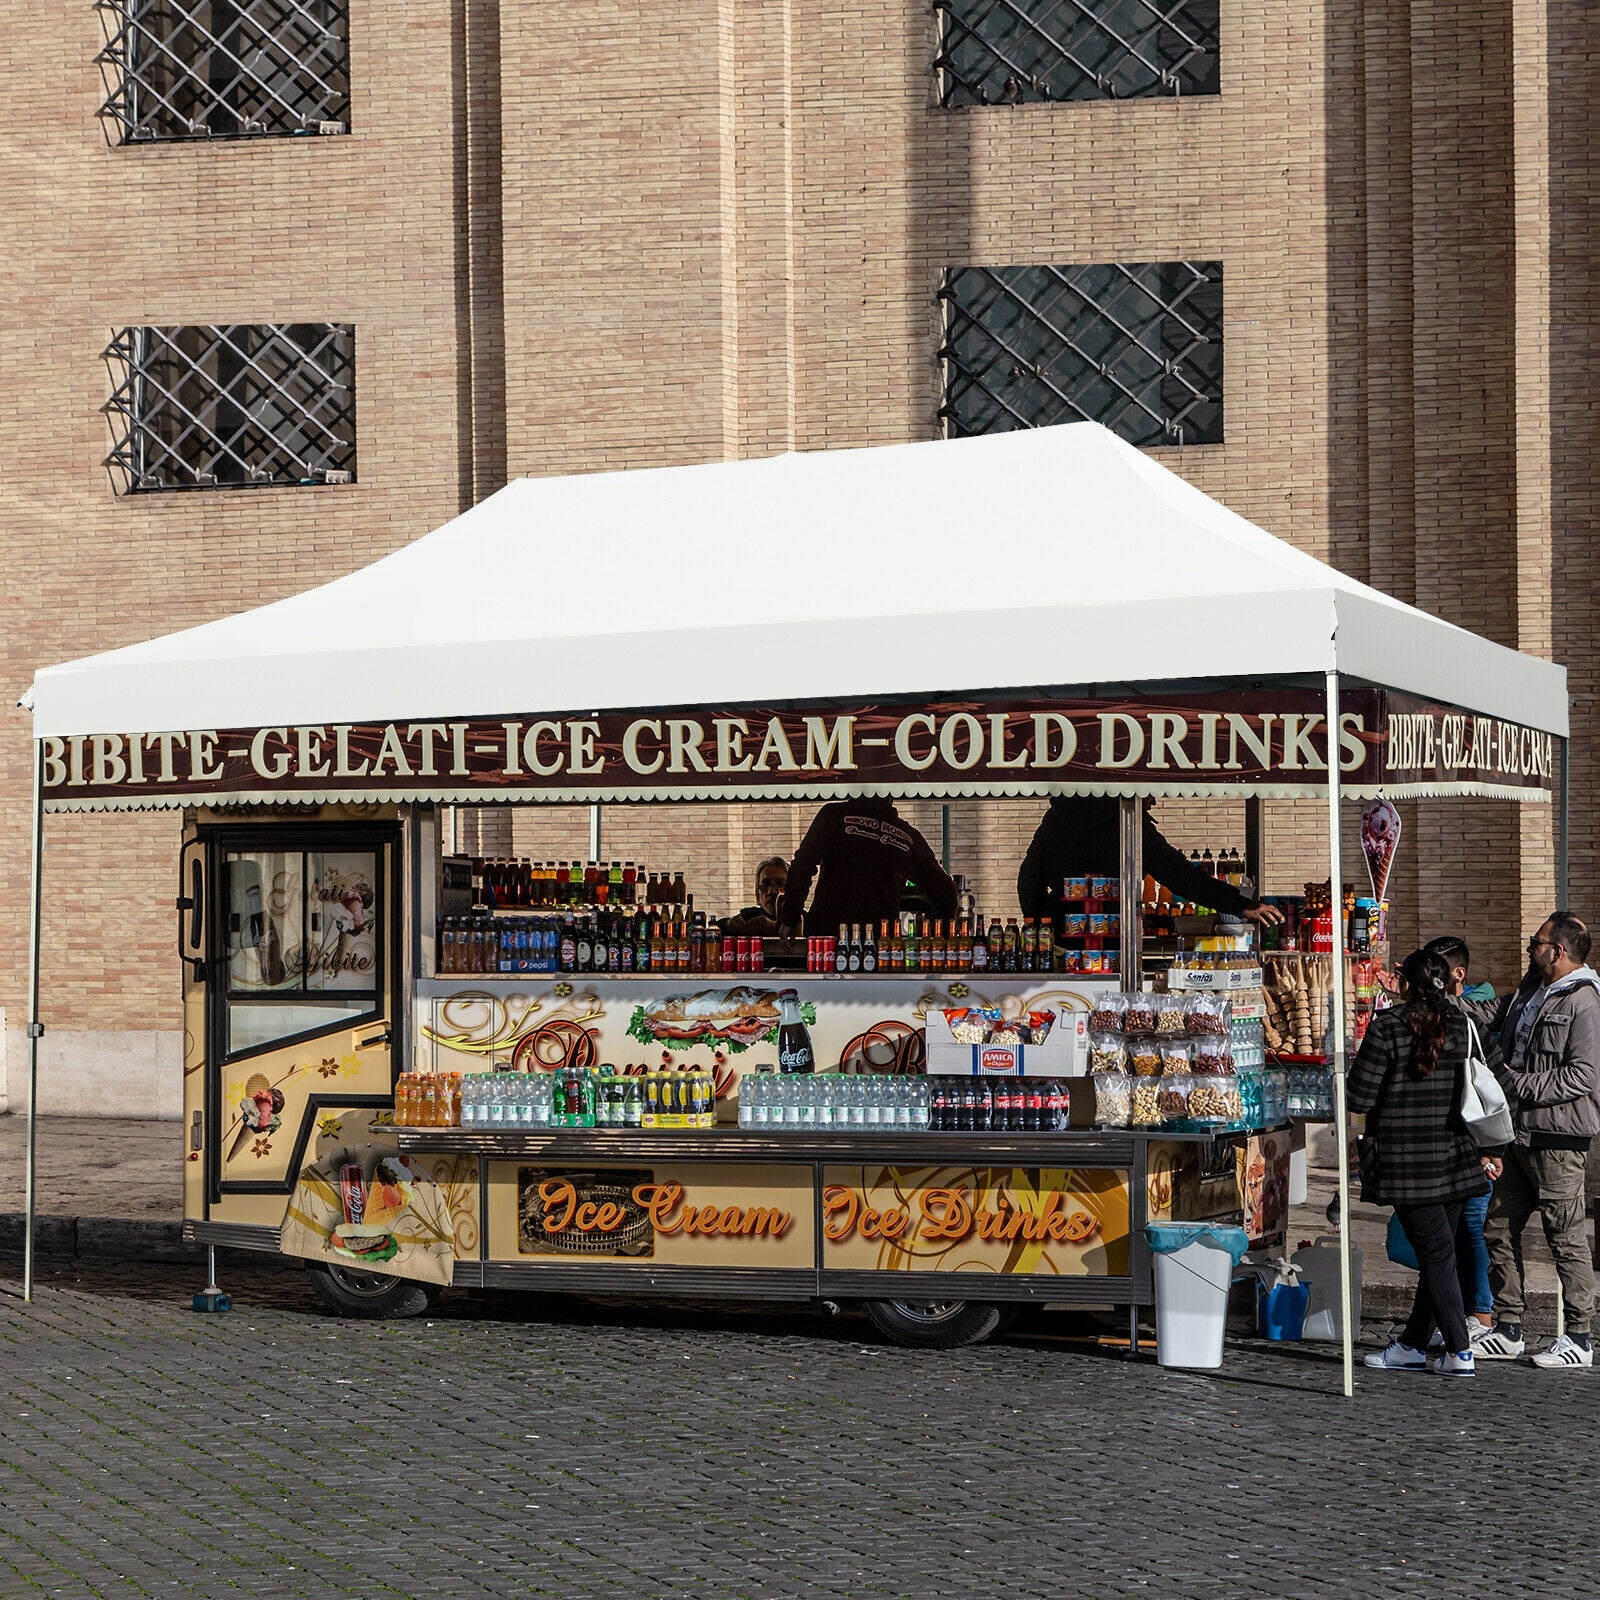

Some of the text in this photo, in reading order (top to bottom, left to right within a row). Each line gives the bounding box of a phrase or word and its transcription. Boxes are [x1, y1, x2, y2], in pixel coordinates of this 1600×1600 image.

[1094, 710, 1367, 772] DRINKS
[528, 961, 548, 969] pepsi
[983, 1053, 1013, 1062] AMICA
[538, 1177, 791, 1235] Ice Cream
[823, 1184, 1098, 1242] Ice Drinks
